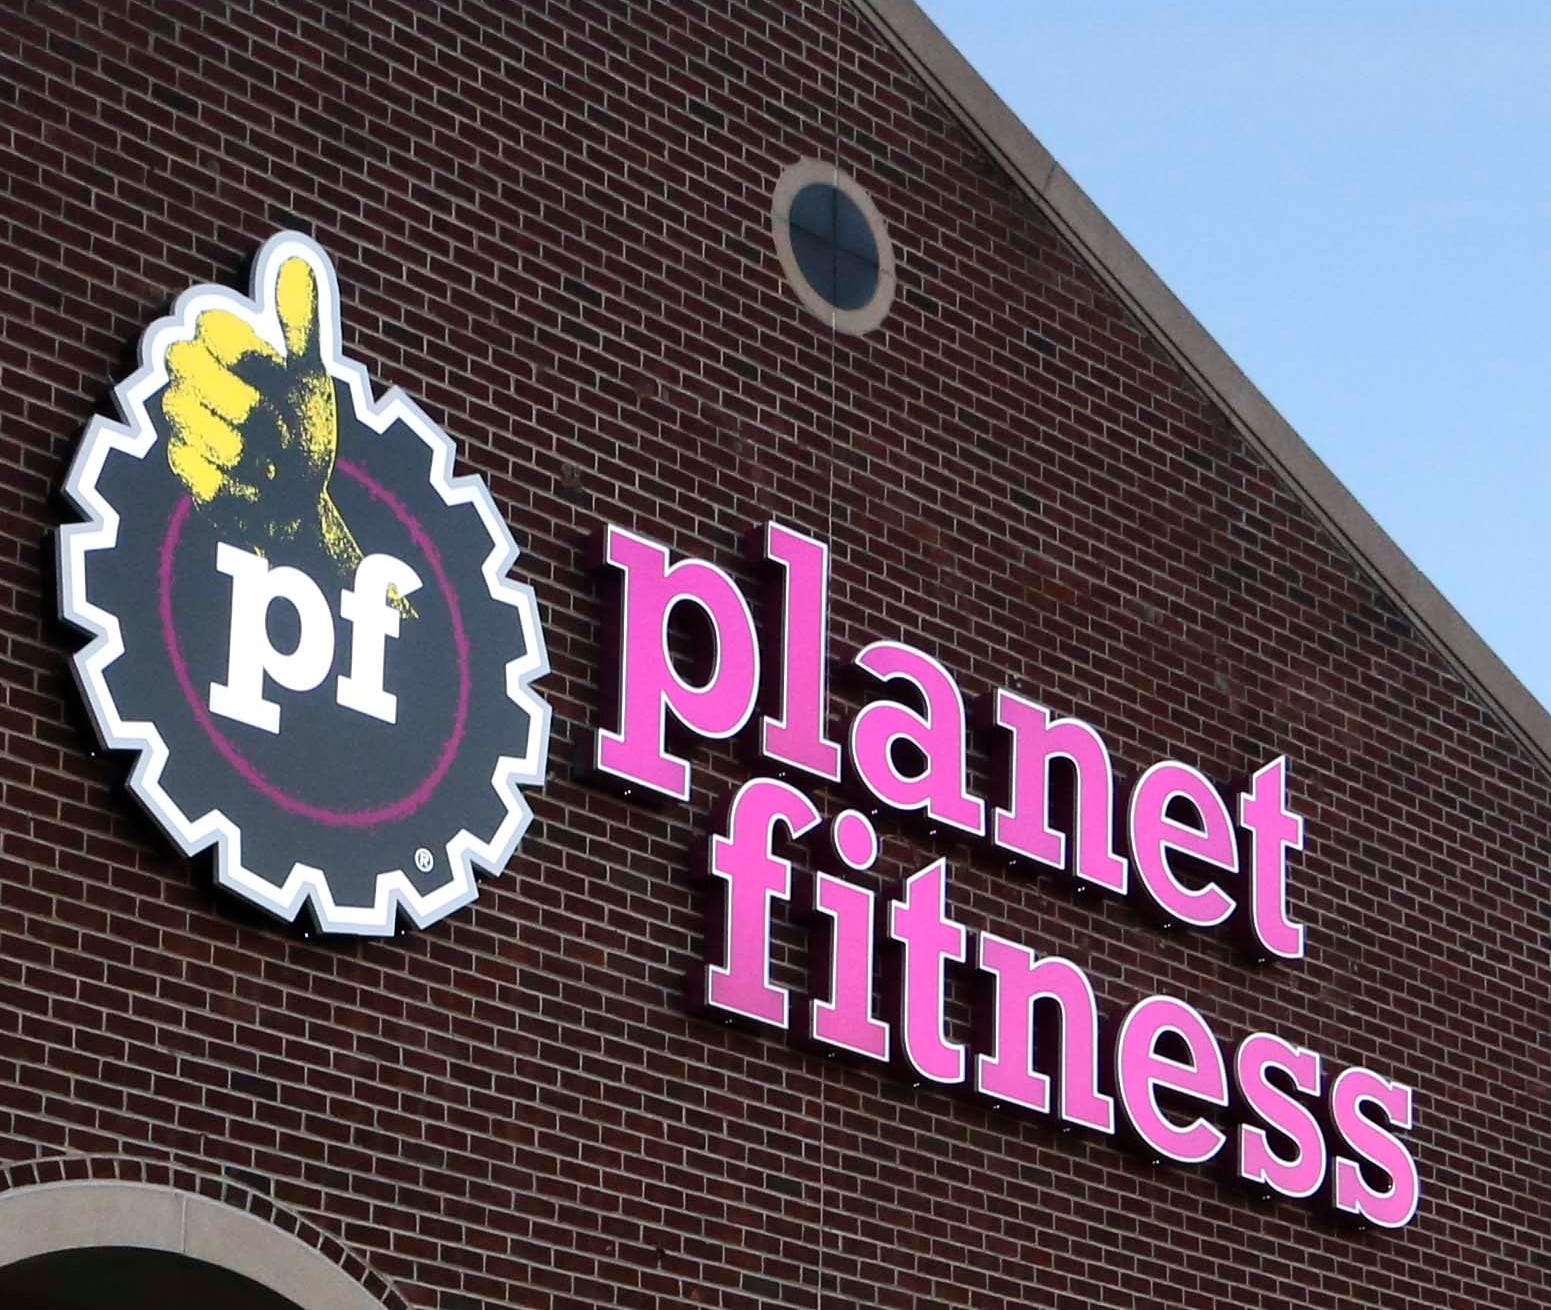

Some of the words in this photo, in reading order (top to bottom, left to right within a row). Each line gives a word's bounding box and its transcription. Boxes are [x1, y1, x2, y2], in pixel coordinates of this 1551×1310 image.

[209, 541, 423, 734] pf
[596, 520, 1306, 959] planet
[706, 777, 1421, 1229] fitness
